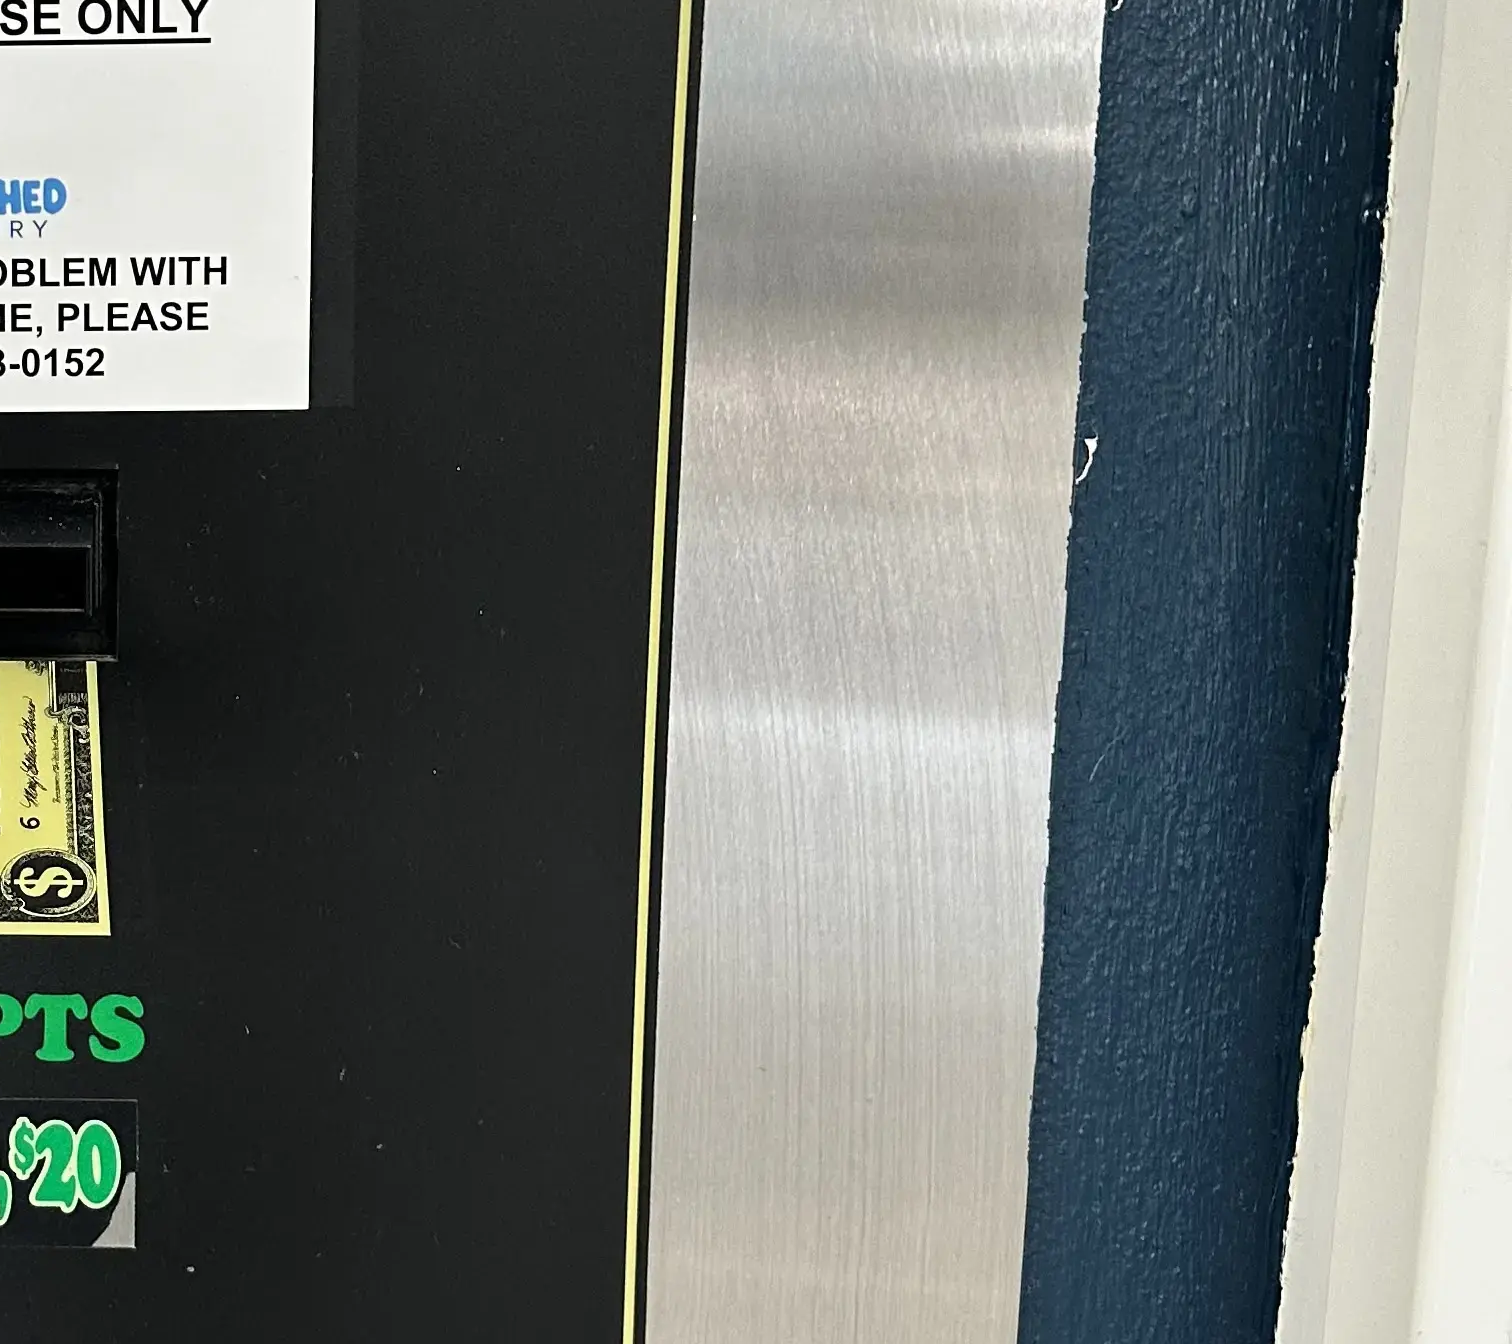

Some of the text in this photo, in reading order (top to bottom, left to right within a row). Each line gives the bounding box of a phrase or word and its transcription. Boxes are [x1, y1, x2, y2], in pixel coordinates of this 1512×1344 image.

[129, 256, 228, 286] WITH
[57, 301, 209, 332] PLEASE
[19, 816, 41, 830] 6
